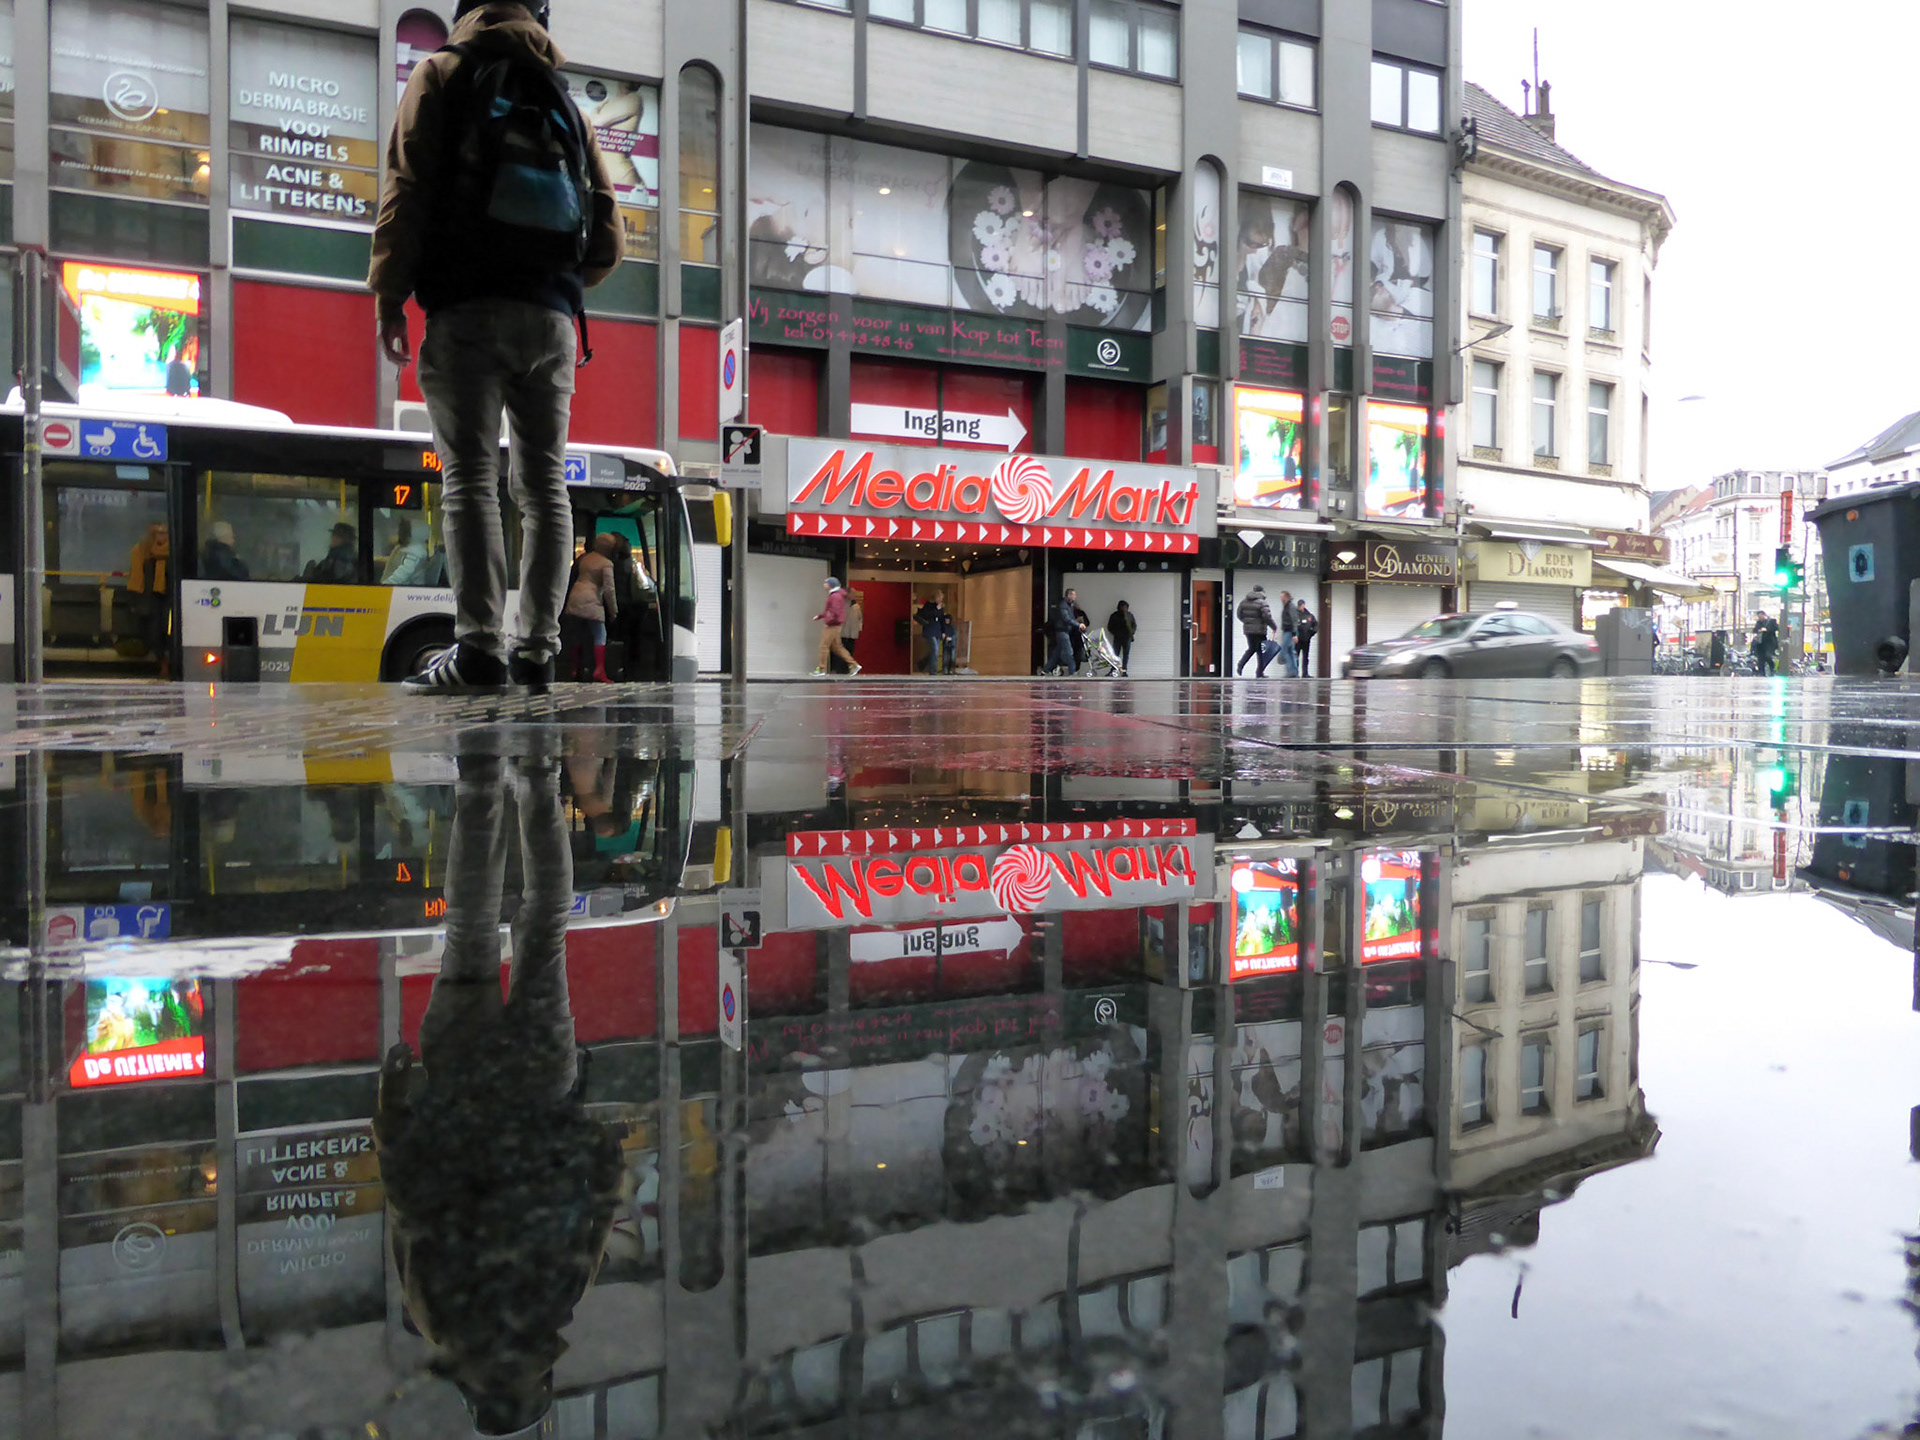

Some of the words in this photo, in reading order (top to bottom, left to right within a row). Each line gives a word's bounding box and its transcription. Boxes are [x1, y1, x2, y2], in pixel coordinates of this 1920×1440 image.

[269, 70, 340, 97] MICRO
[239, 89, 368, 123] DERMABRASIE
[259, 134, 349, 162] RIMPELS
[265, 163, 323, 187] ACNE
[328, 172, 344, 190] &
[240, 183, 367, 215] LITTEKENS
[777, 307, 839, 328] zorgen
[853, 315, 893, 331] voor
[900, 321, 910, 333] u
[916, 323, 945, 336] van
[952, 320, 990, 346] Kop
[997, 329, 1020, 346] tot
[1025, 329, 1063, 349] Teen
[1330, 322, 1349, 335] STOP
[871, 334, 891, 348] 48
[894, 337, 914, 351] 46
[903, 409, 981, 439] Ingang
[393, 484, 411, 506] 17
[624, 480, 647, 491] 5025
[791, 448, 992, 513] Media
[1046, 467, 1200, 526] Markt
[1262, 538, 1317, 554] WHITE
[1386, 558, 1452, 577] DIAMOND
[1415, 553, 1450, 564] CENTER
[1506, 550, 1574, 579] DIAMONDS
[1545, 553, 1574, 566] EDEN
[262, 614, 345, 637] LIJN
[260, 660, 291, 672] 5025
